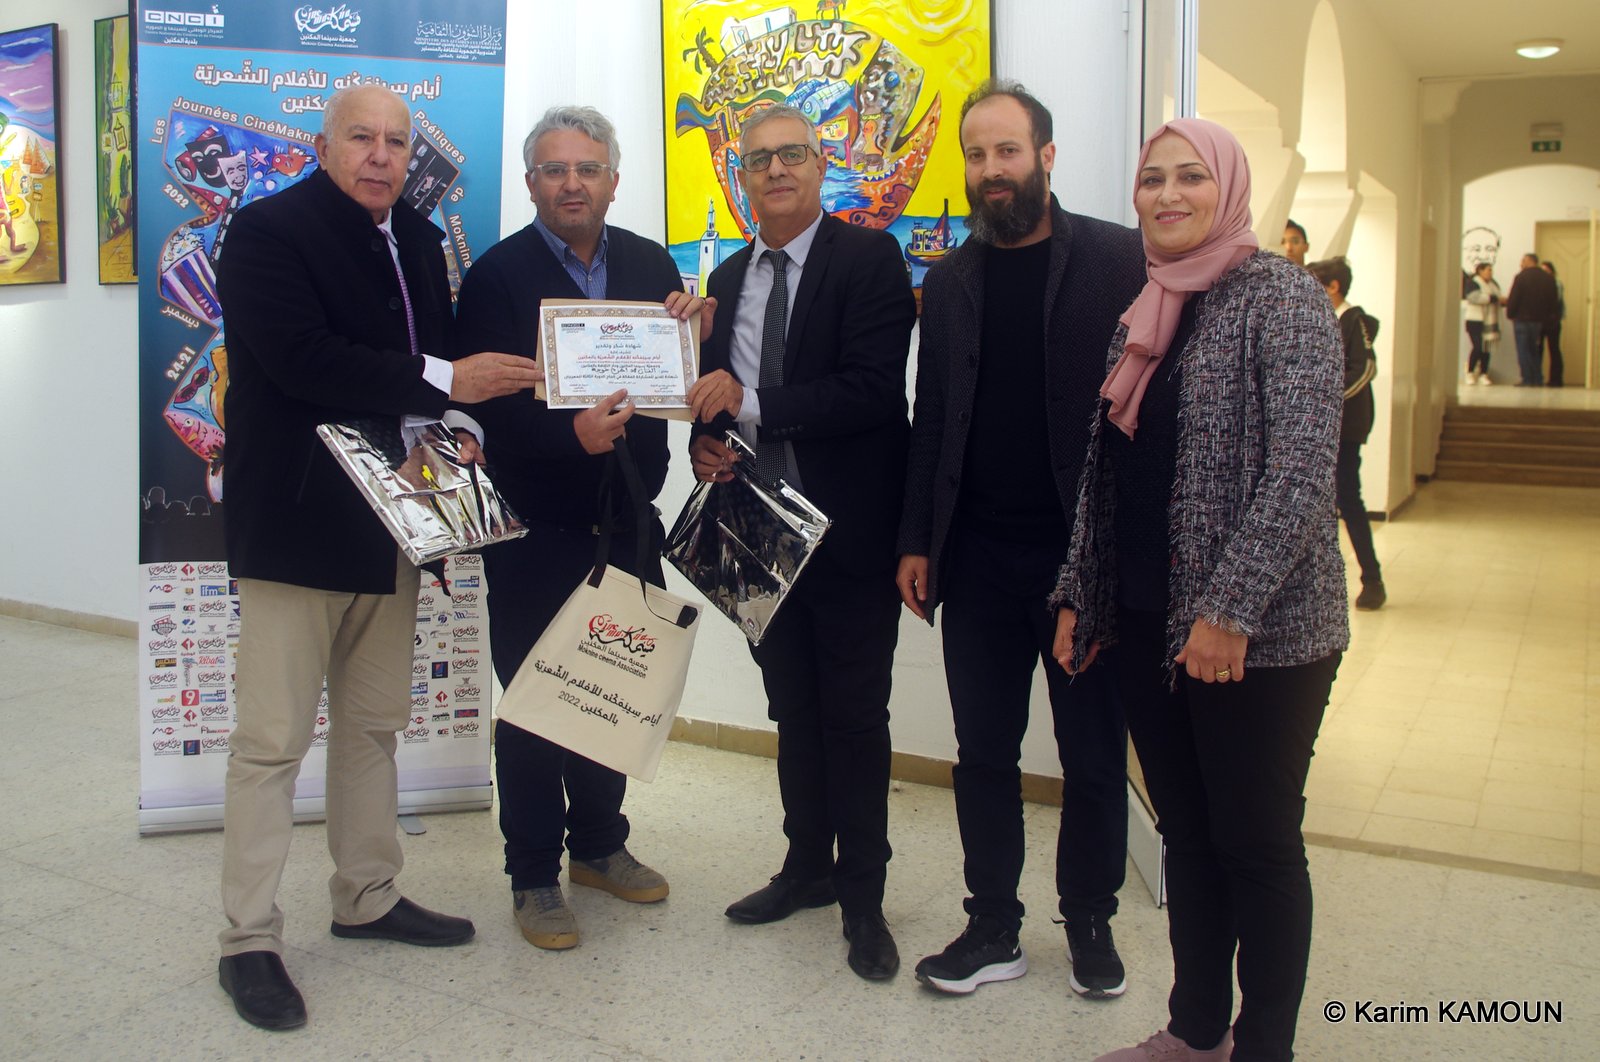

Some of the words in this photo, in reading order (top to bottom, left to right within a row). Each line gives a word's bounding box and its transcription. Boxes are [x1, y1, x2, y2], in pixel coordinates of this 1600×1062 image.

[145, 9, 224, 27] CNCI
[322, 34, 339, 42] سينما
[339, 35, 357, 43] جمعية
[272, 66, 327, 91] للأفلام
[412, 75, 442, 101] أيام
[151, 119, 166, 144] Les
[173, 97, 238, 123] Journées
[414, 111, 465, 164] Poétiques
[163, 184, 190, 208] 2022
[451, 187, 465, 202] de
[449, 215, 473, 269] Moknine
[162, 305, 200, 328] ديسمبر
[580, 638, 607, 653] المكنين
[608, 648, 627, 661] سينما
[577, 644, 598, 659] Moknine
[617, 661, 647, 679] Association
[628, 658, 648, 672] جمعية
[566, 680, 602, 696] للأفلام
[558, 691, 580, 707] 2022
[580, 703, 618, 726] بالمكنين
[640, 713, 662, 726] أيام
